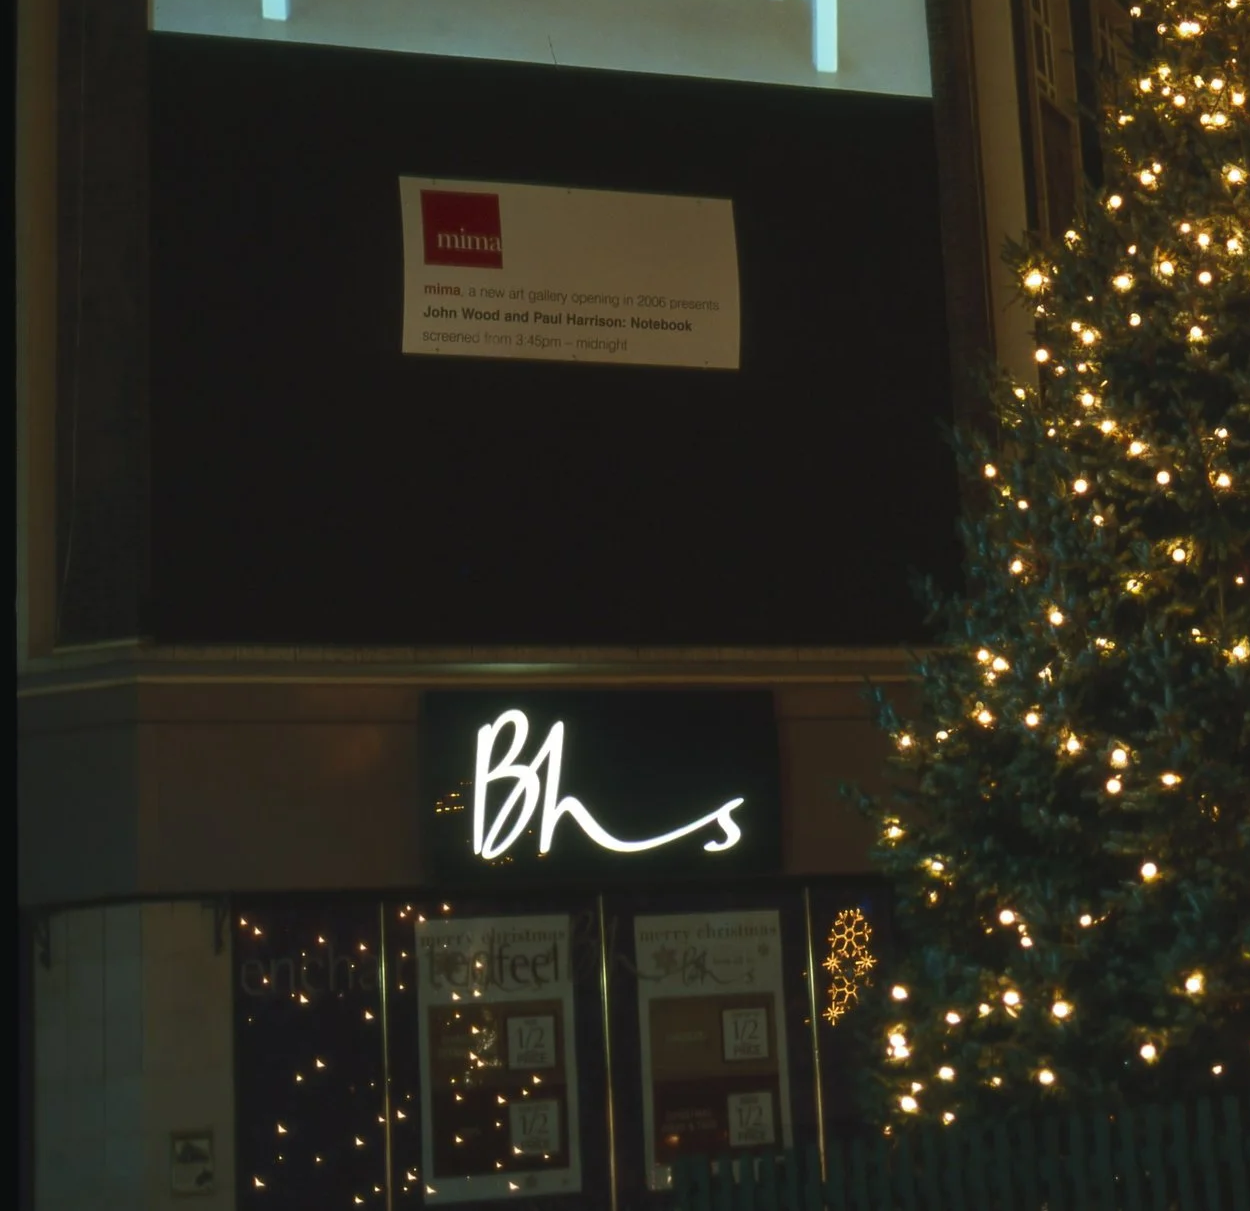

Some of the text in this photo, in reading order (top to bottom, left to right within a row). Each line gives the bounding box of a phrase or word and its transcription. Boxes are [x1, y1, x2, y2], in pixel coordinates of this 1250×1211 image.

[438, 227, 502, 252] mima
[468, 286, 477, 297] a
[480, 287, 504, 298] new
[508, 288, 524, 300] art
[528, 289, 567, 304] gallery
[571, 292, 620, 308] opening
[623, 294, 634, 306] in
[636, 295, 666, 308] 2006
[669, 298, 720, 311] presents
[423, 305, 693, 332] John Wood and Paul Harrison: Notebook
[422, 330, 480, 344] screened
[484, 331, 512, 345] from
[516, 334, 561, 350] 3:45pm
[576, 336, 628, 353] midnight
[472, 709, 744, 859] Bhs
[518, 1026, 545, 1049] 1/2
[733, 1019, 760, 1041] 1/2
